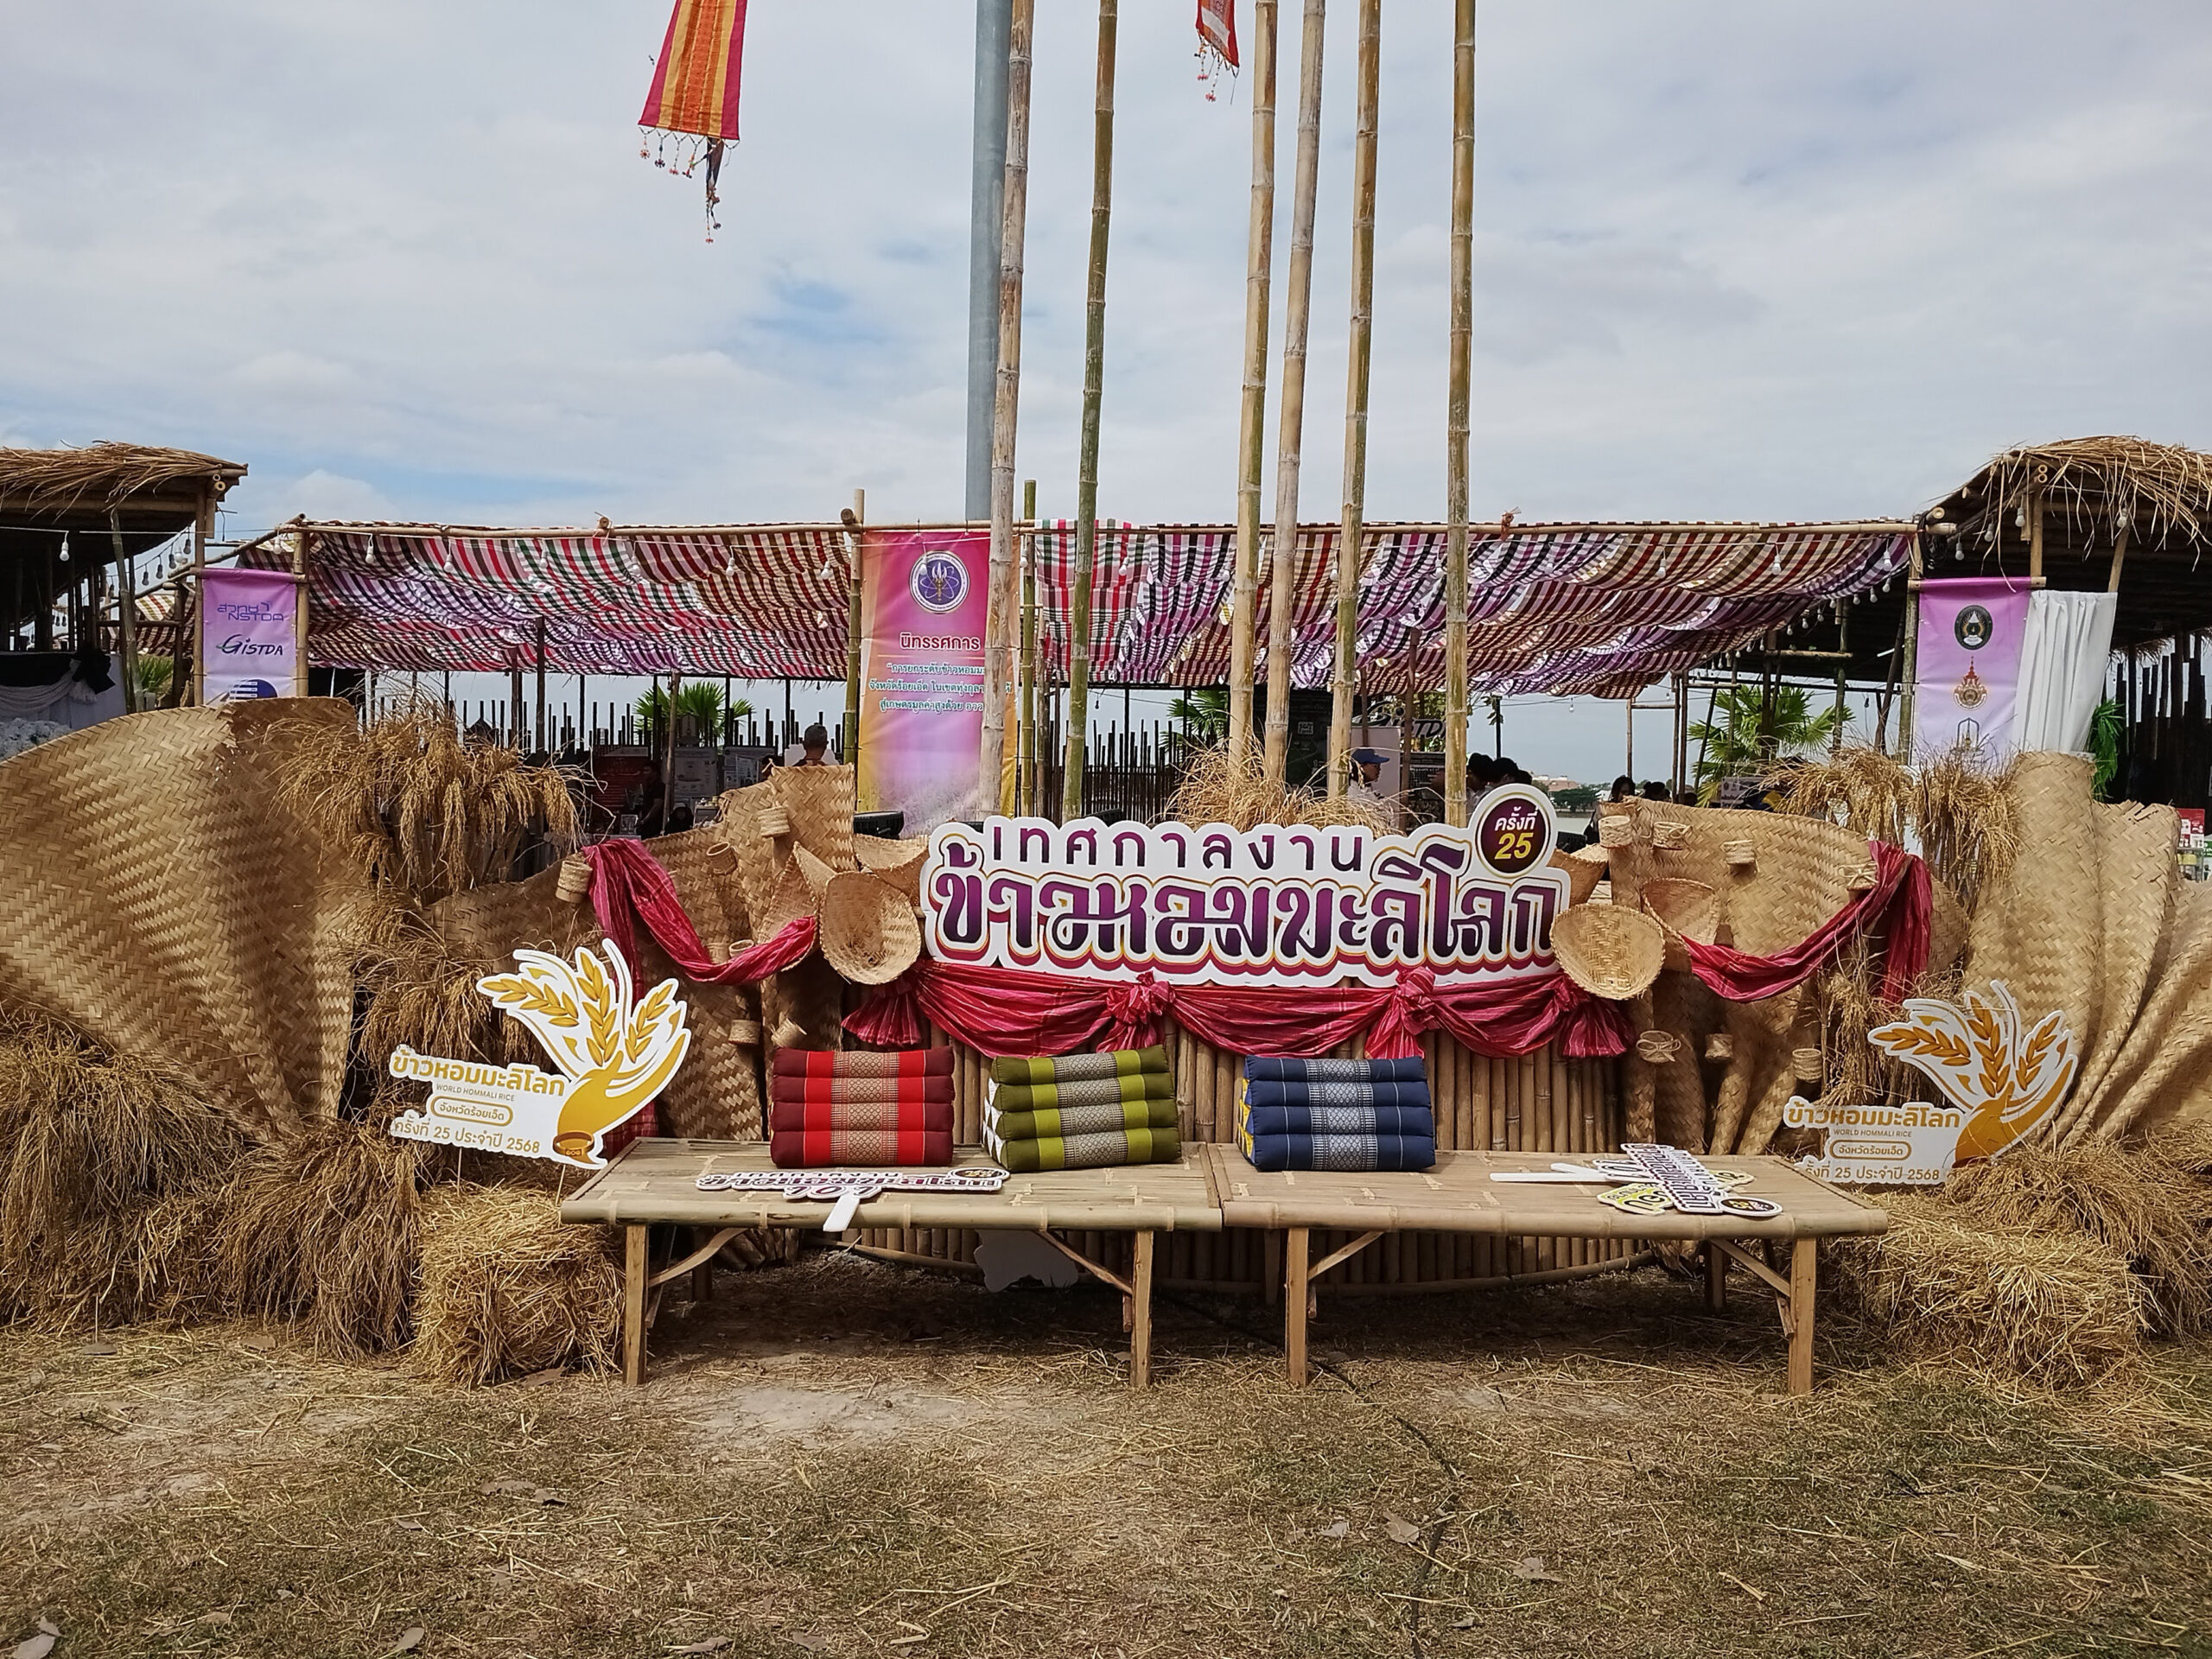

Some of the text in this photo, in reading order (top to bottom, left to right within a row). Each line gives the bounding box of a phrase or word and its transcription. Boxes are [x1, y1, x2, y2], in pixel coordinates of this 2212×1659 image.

[228, 612, 284, 621] NSTDA
[900, 632, 980, 650] นิทรรศการ
[1494, 806, 1538, 831] ครั้งที่
[993, 826, 1363, 872] เทศกาลงาน
[1494, 832, 1534, 860] 25
[936, 842, 1556, 959] ข้าวหอมมะลิโลก
[393, 1048, 565, 1096] ข้าวหอมมะลิโลก
[436, 1084, 515, 1102] WORLD HOMMALI RICE
[439, 1102, 505, 1121] จังหวัดร้อยเอ็ด
[1788, 1101, 1961, 1128] ข้าวหอมมะลิโลก
[394, 1114, 540, 1154] ครั้งที่ 25 ประจำปี 2568
[1839, 1145, 1903, 1155] จังหวัดร้อยเอ็ด
[1804, 1160, 1940, 1180] รั้งที่ 25 ประจำปี 2568
